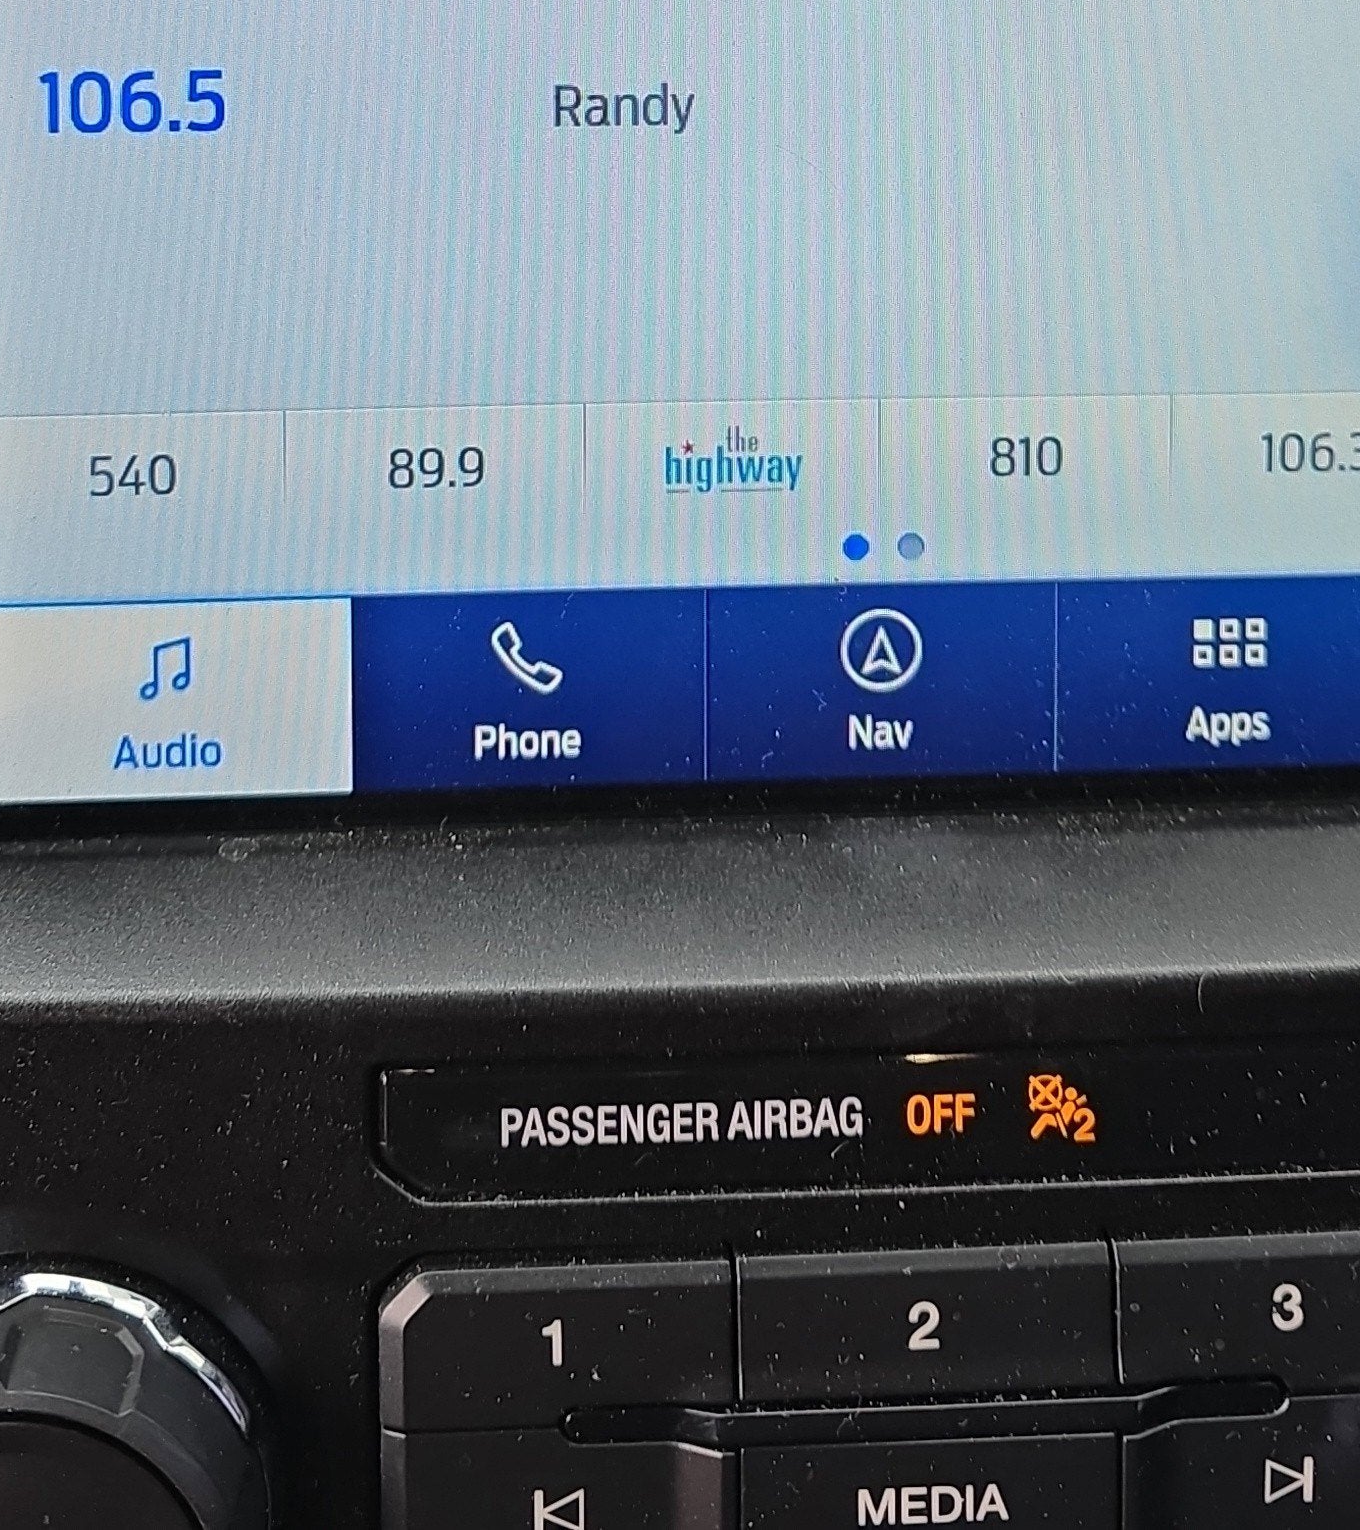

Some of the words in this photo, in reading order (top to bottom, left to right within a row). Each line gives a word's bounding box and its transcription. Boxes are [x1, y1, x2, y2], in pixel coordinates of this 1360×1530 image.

[40, 70, 224, 133] 106.5
[554, 83, 694, 134] Randy
[726, 425, 759, 453] the
[990, 436, 1063, 477] 810
[90, 455, 176, 497] 540
[389, 447, 484, 489] 89.9
[665, 442, 803, 493] highway
[475, 724, 581, 759] Phone
[849, 715, 912, 749] Nav
[1186, 707, 1270, 746] Apps
[114, 734, 221, 769] Audio
[502, 1103, 719, 1147] PASSENGER
[728, 1097, 862, 1139] AIRBAG
[907, 1093, 975, 1134] OFF
[909, 1301, 939, 1350] 2
[1273, 1284, 1303, 1330] 3
[542, 1320, 562, 1365] 1
[858, 1484, 1008, 1525] MEDIA
